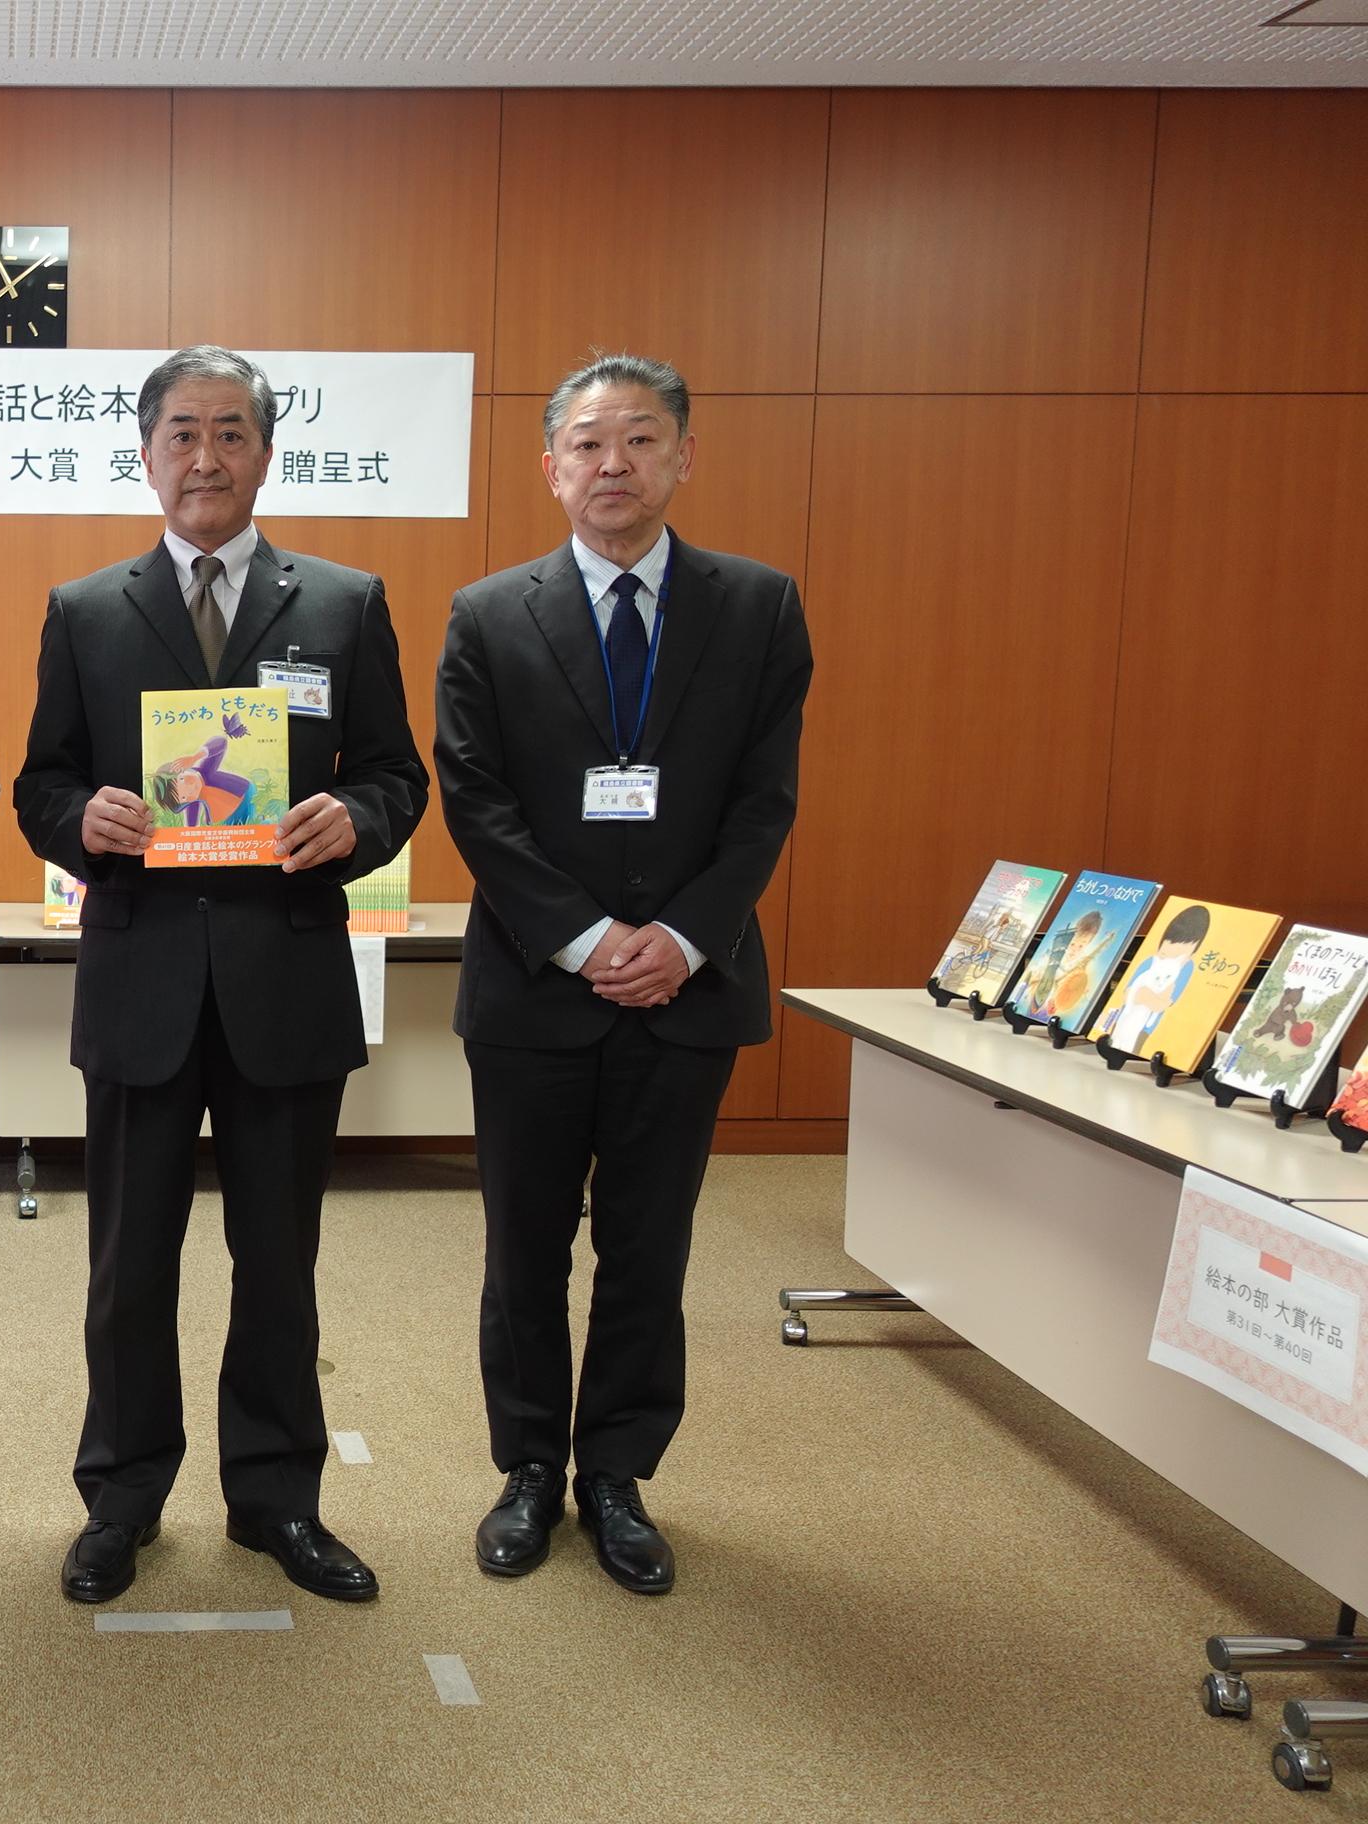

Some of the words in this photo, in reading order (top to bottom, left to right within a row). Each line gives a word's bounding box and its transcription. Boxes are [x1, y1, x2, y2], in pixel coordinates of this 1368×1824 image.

[9, 447, 79, 482] 大賞
[282, 449, 390, 484] 贈呈式
[152, 706, 214, 726] うらがわ
[221, 695, 279, 722] ともだち
[177, 850, 259, 862] 絵本大賞受賞作品
[1205, 1265, 1270, 1313] 絵本の部
[1274, 1300, 1344, 1350] 大賞作品
